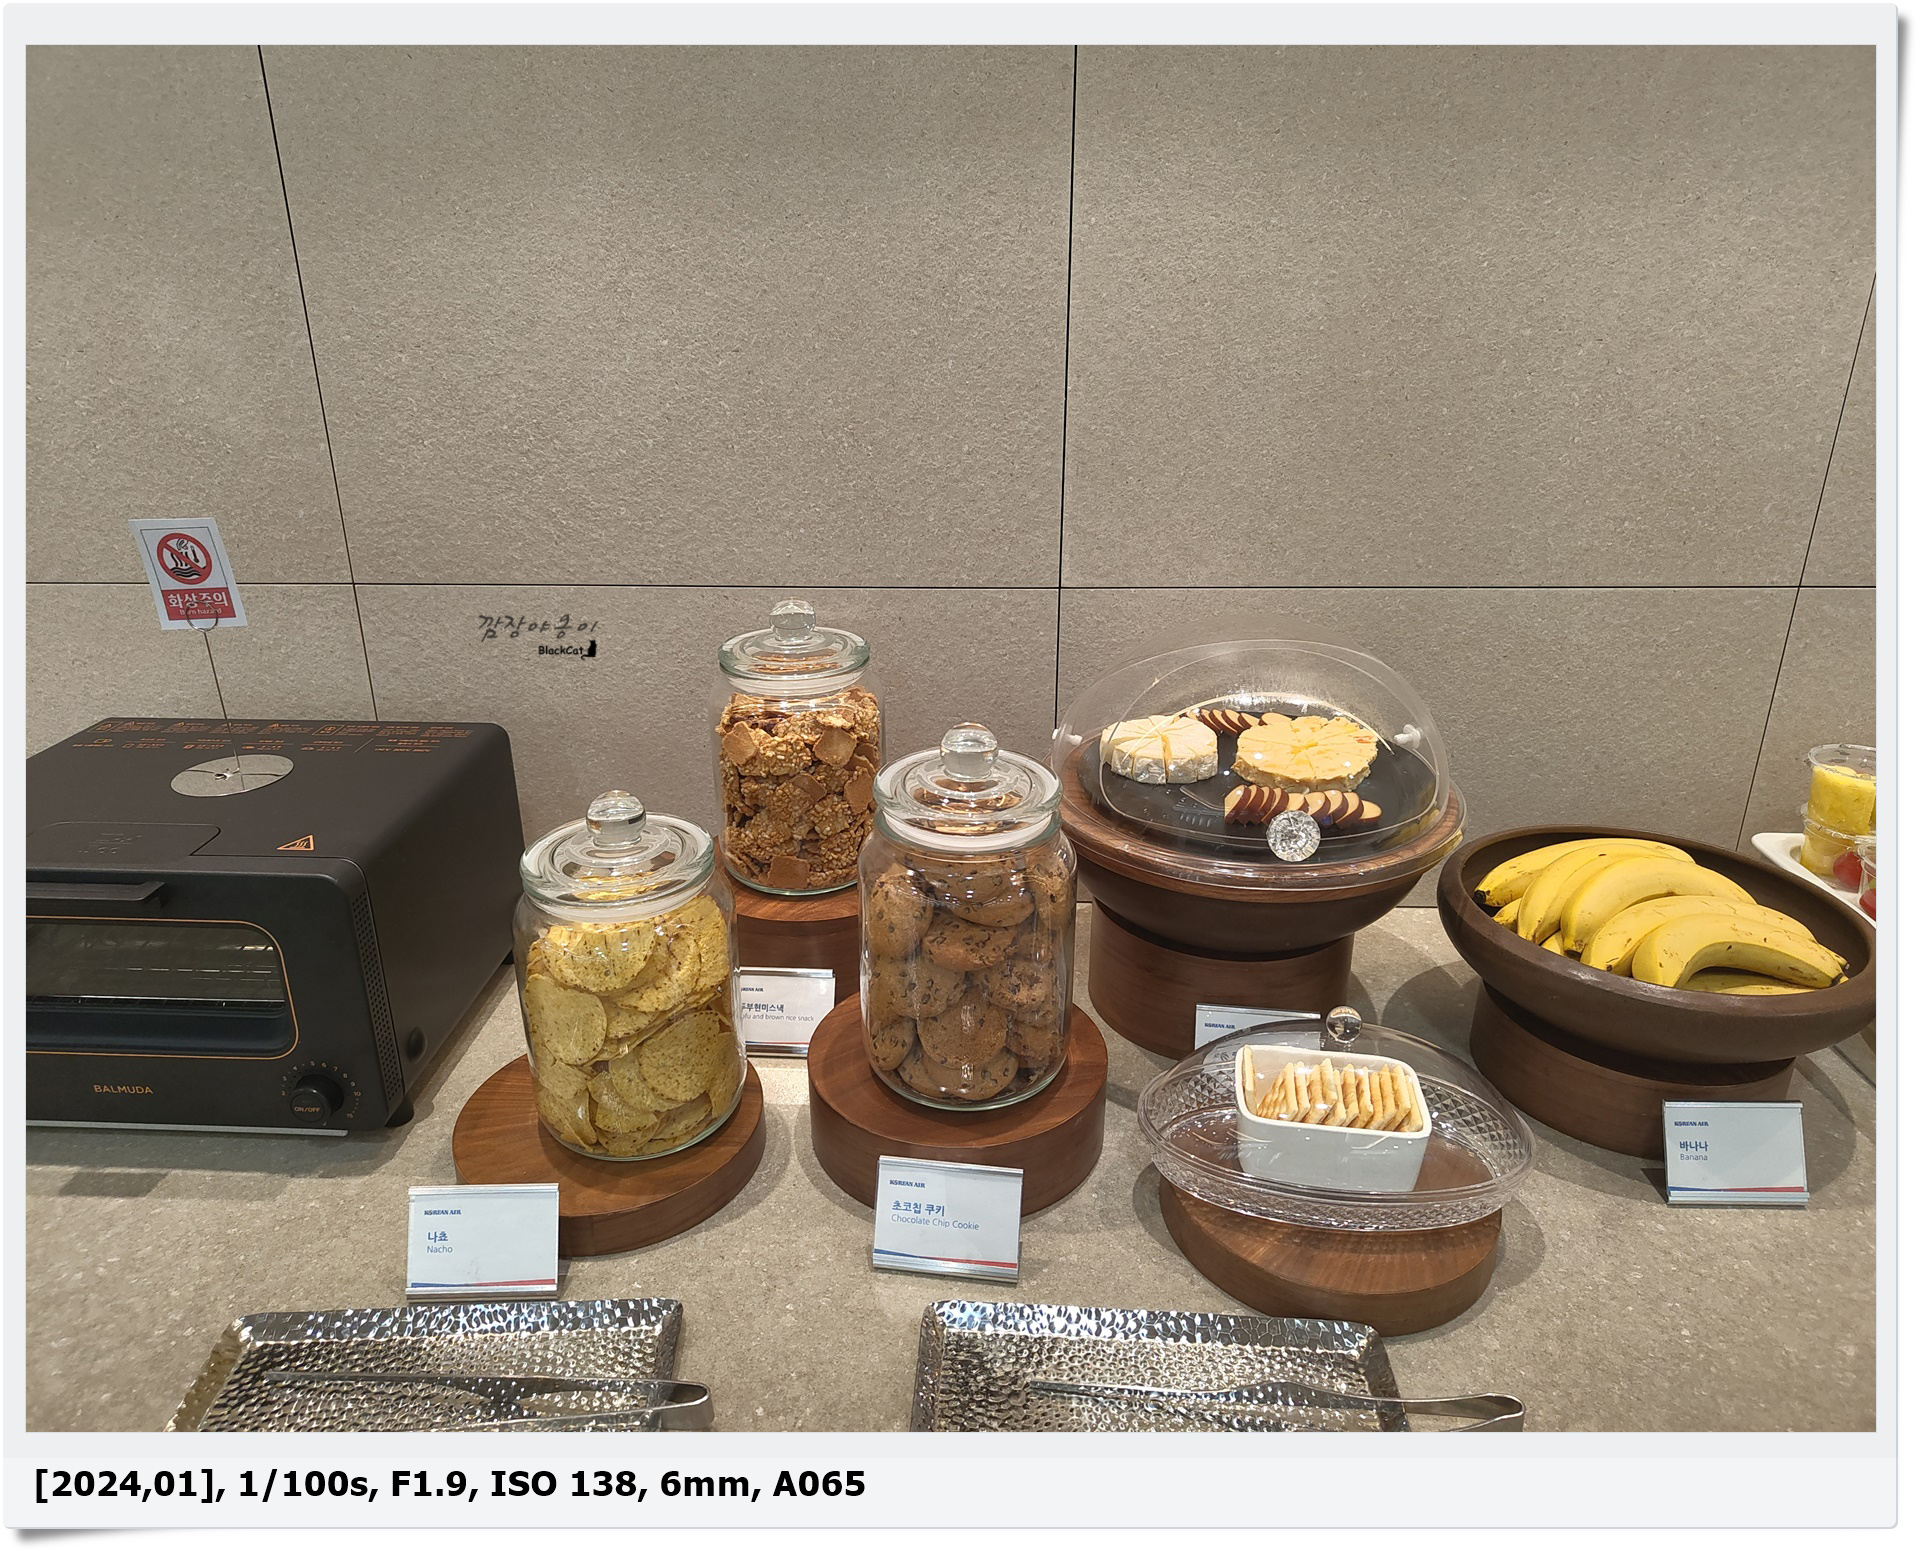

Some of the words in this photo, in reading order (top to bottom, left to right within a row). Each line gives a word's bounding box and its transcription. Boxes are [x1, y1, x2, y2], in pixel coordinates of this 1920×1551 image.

[167, 591, 229, 609] 화상주의
[765, 1013, 785, 1021] brown
[93, 1084, 154, 1094] BALMUDA
[1679, 1140, 1709, 1151] 바나나
[889, 1179, 913, 1187] KOREAN
[891, 1200, 922, 1214] 초코칩
[924, 1203, 945, 1217] 쿠키
[891, 1213, 930, 1226] Chocolate
[932, 1217, 950, 1228] Chip
[952, 1220, 980, 1231] Cookie
[427, 1231, 449, 1243] 나쵸
[426, 1244, 453, 1253] Nacho
